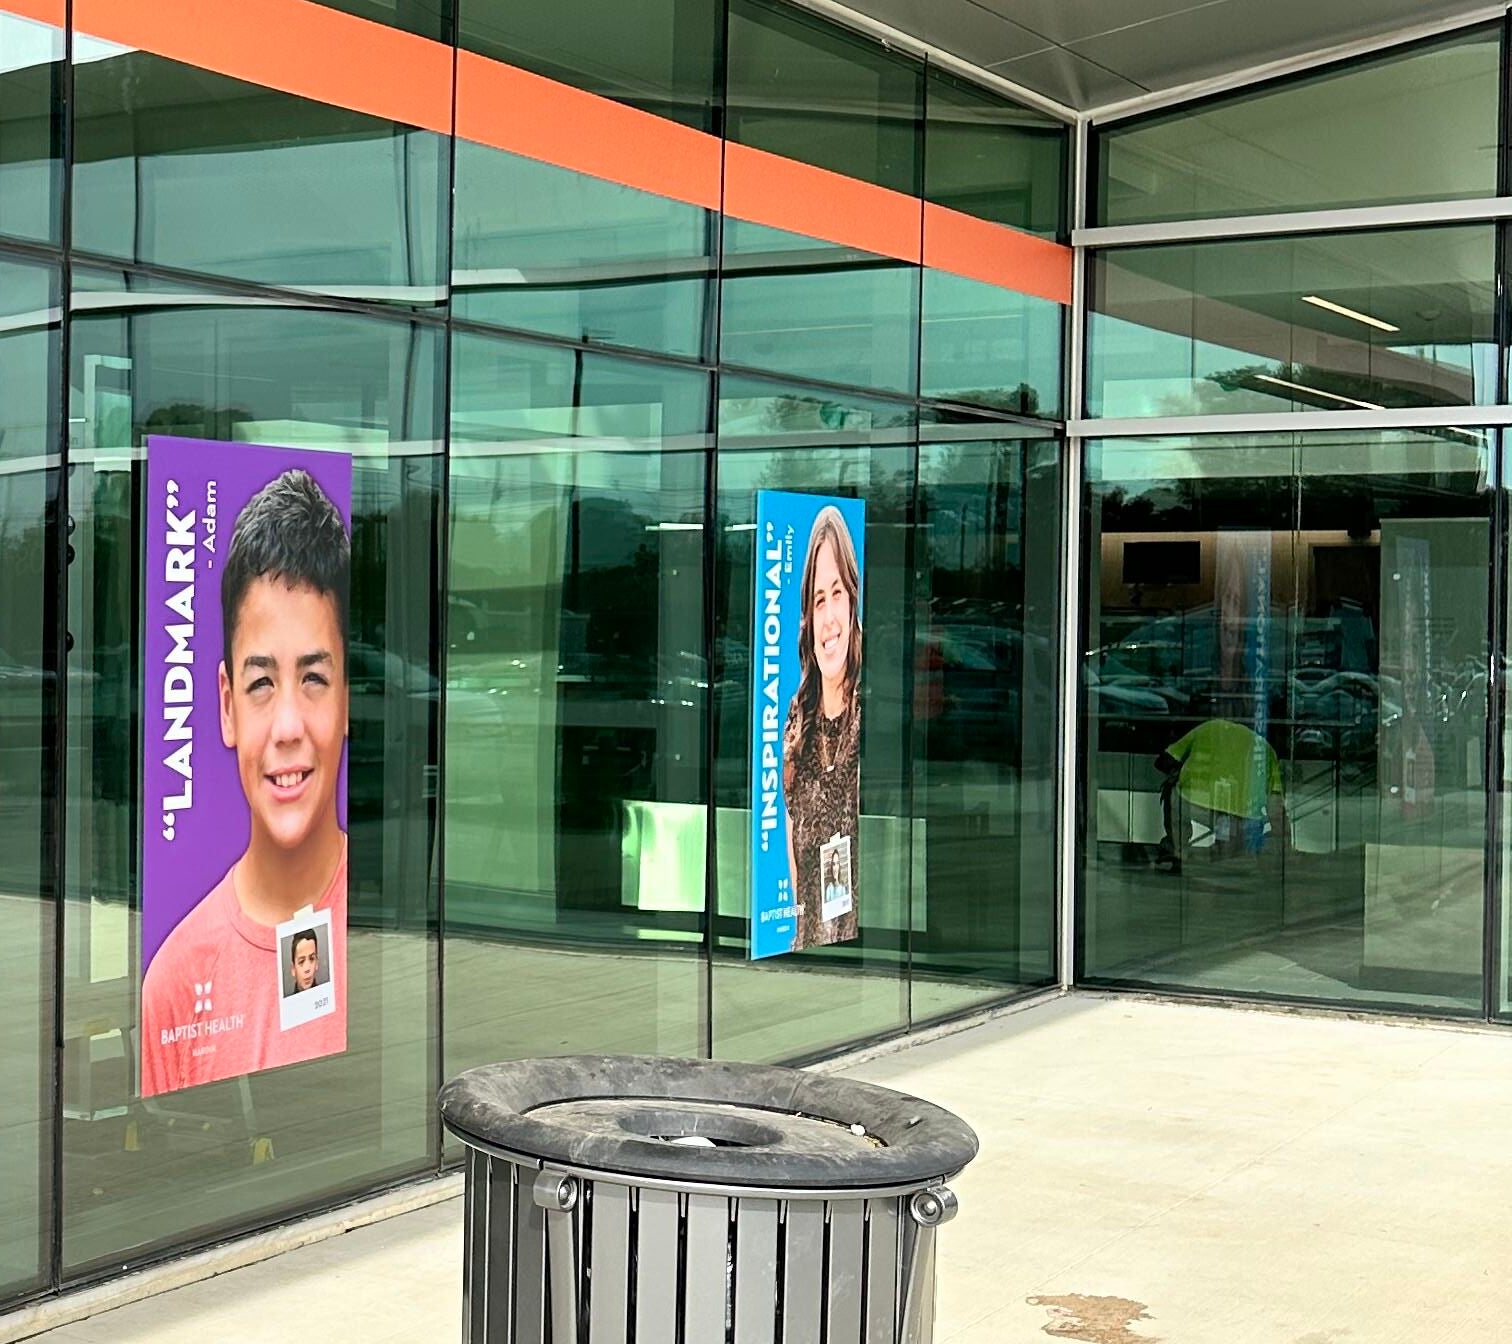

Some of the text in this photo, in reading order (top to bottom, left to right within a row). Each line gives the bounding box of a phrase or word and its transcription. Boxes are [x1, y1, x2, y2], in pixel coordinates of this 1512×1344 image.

[201, 480, 217, 553] Adam
[784, 524, 794, 574] Emily
[162, 479, 197, 841] “LANDMARK”
[761, 521, 783, 852] “INSPIRATIONAL”
[160, 1014, 245, 1045] BAPTIST HEALTH
